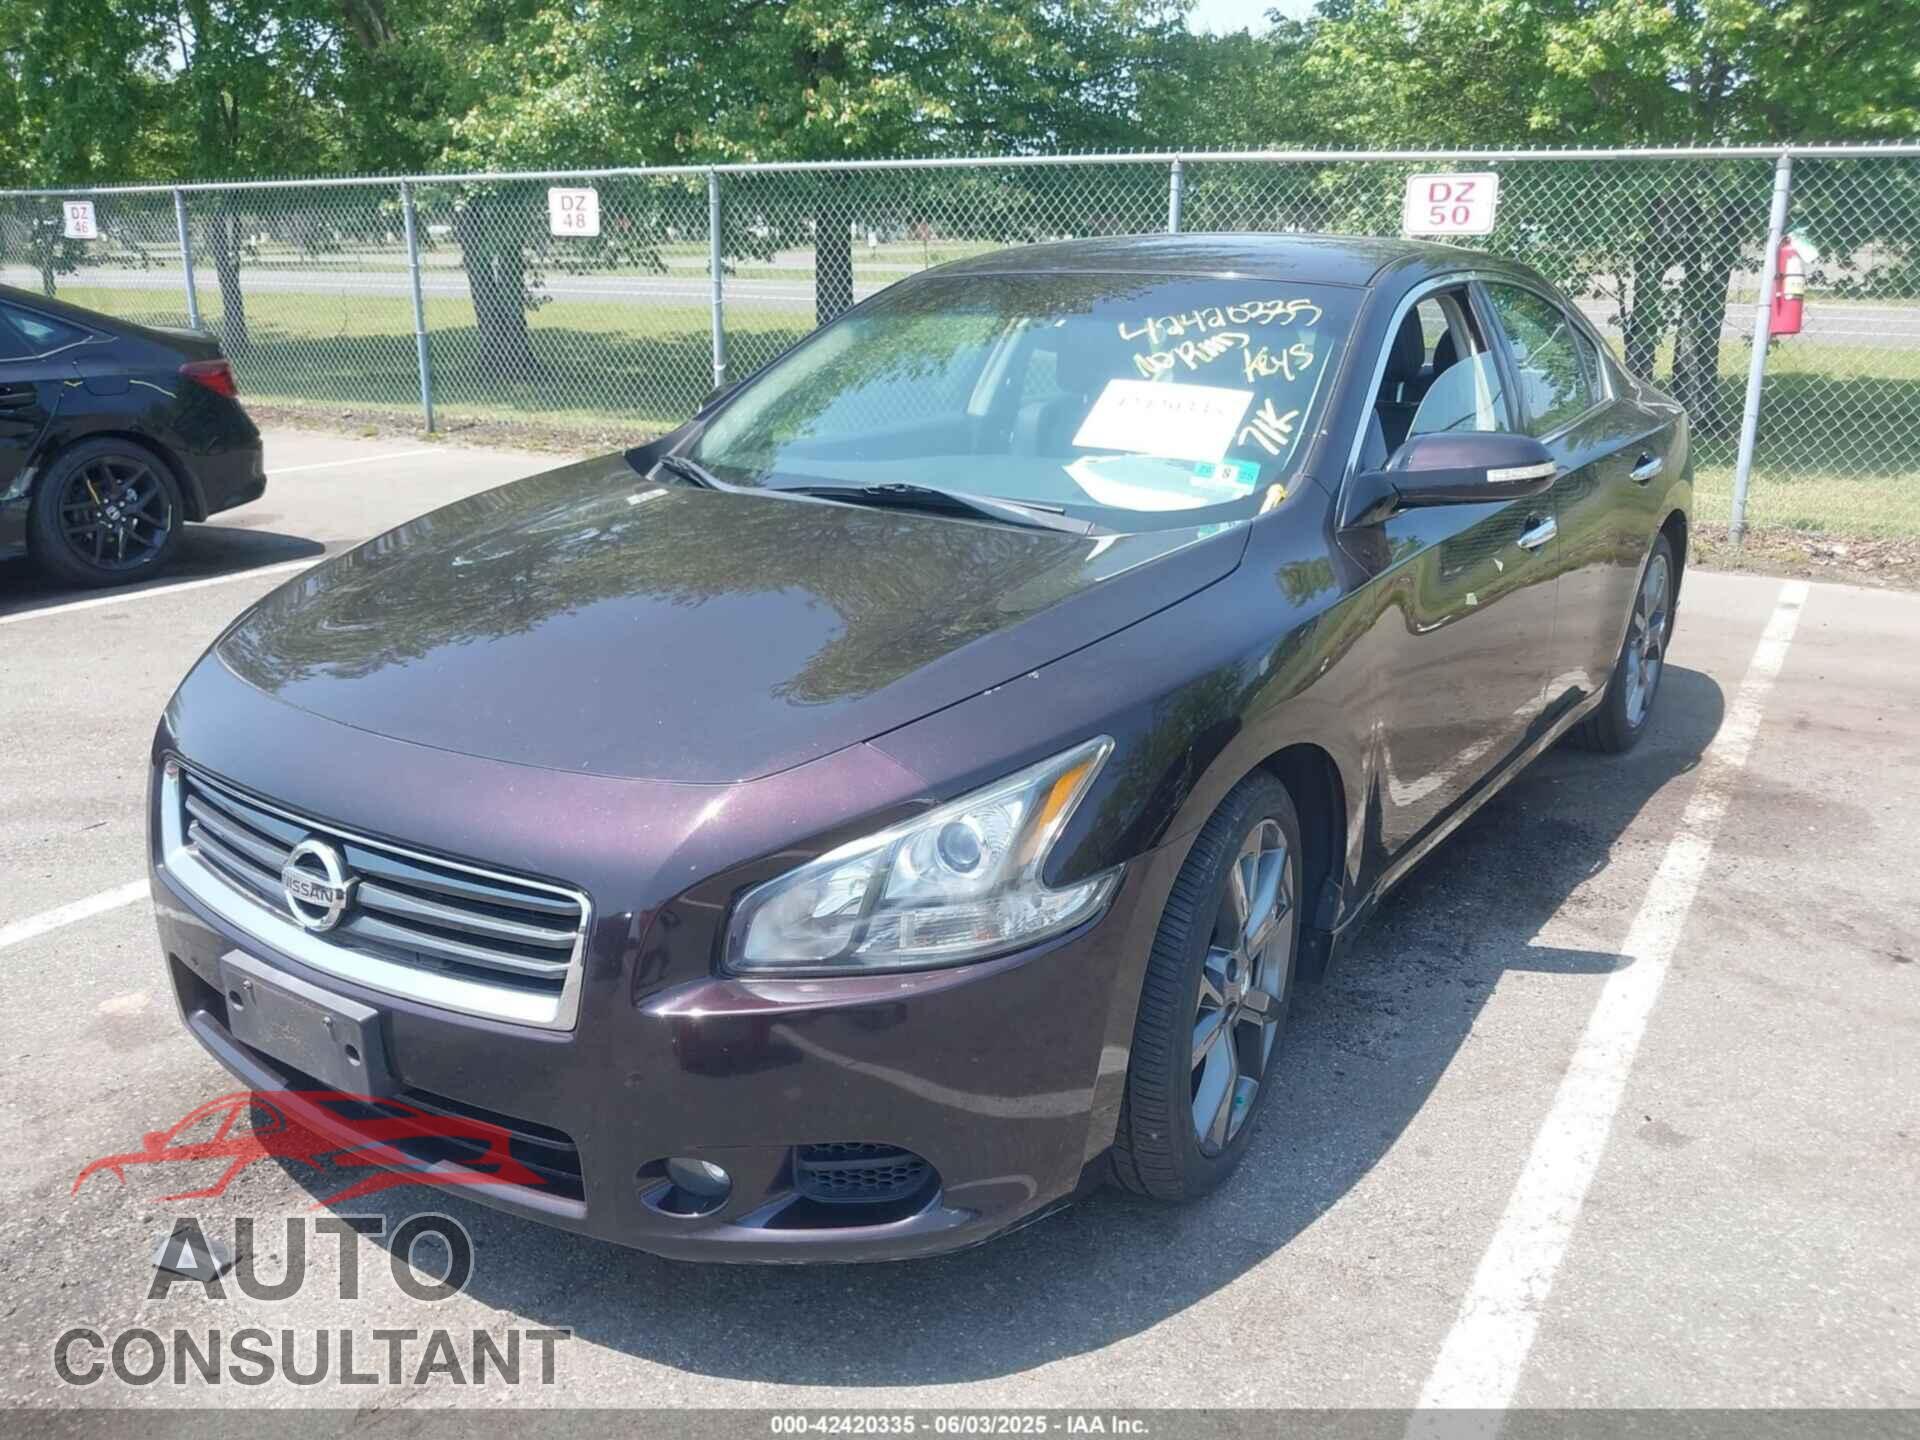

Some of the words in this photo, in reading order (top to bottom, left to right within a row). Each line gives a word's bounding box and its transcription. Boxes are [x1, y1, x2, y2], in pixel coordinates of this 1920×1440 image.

[1428, 181, 1476, 203] DZ
[560, 194, 587, 210] DZ
[71, 206, 89, 220] DZ
[562, 212, 586, 229] 48
[1428, 205, 1471, 226] 50
[1117, 298, 1323, 345] 42420335
